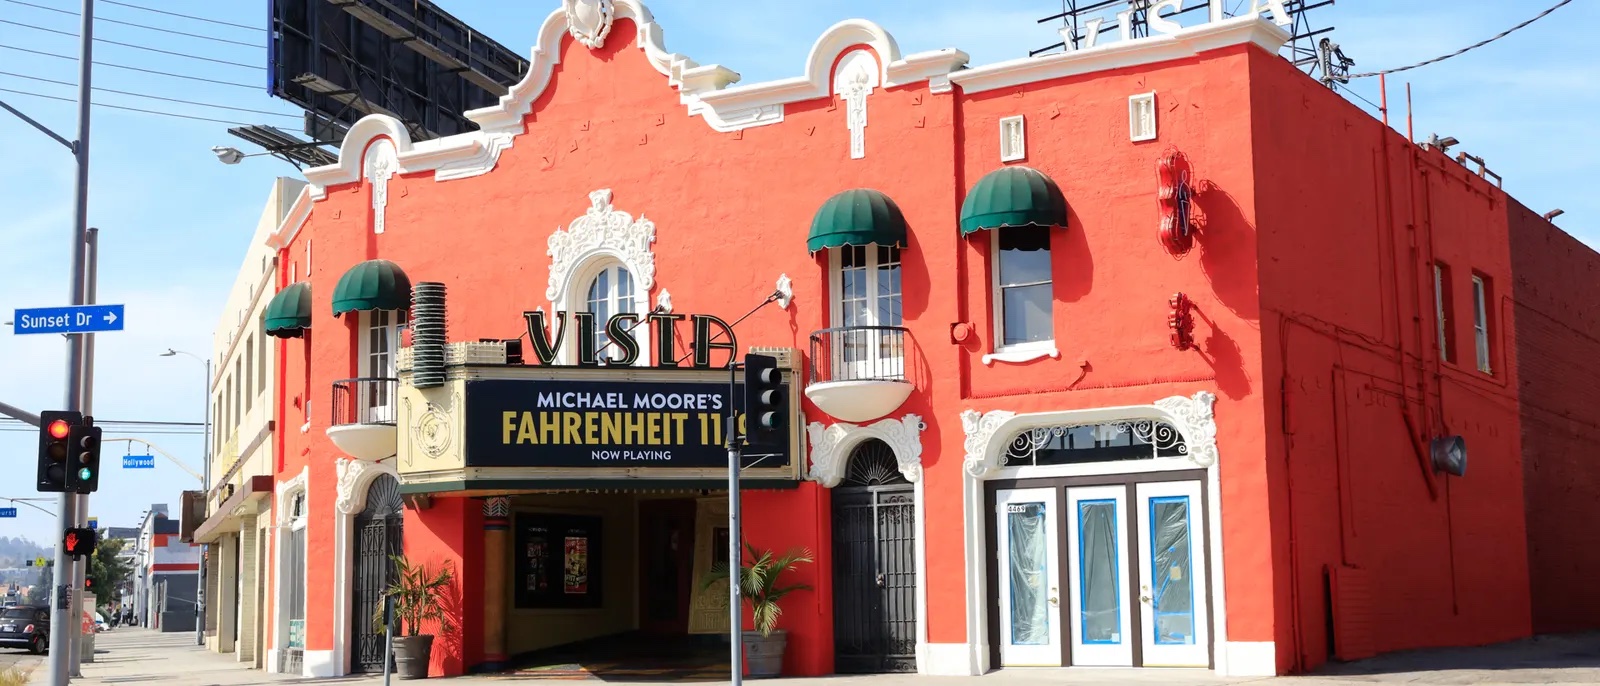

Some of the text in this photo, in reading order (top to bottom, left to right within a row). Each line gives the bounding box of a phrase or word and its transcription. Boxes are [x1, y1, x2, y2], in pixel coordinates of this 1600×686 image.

[21, 312, 92, 329] Sunset Dr
[523, 310, 739, 367] VISTA
[536, 391, 723, 410] MICHAEL MOORE'S
[502, 411, 689, 446] FAHRENHEIT
[123, 458, 154, 467] Hollywood
[591, 450, 672, 461] NOW PLAYING
